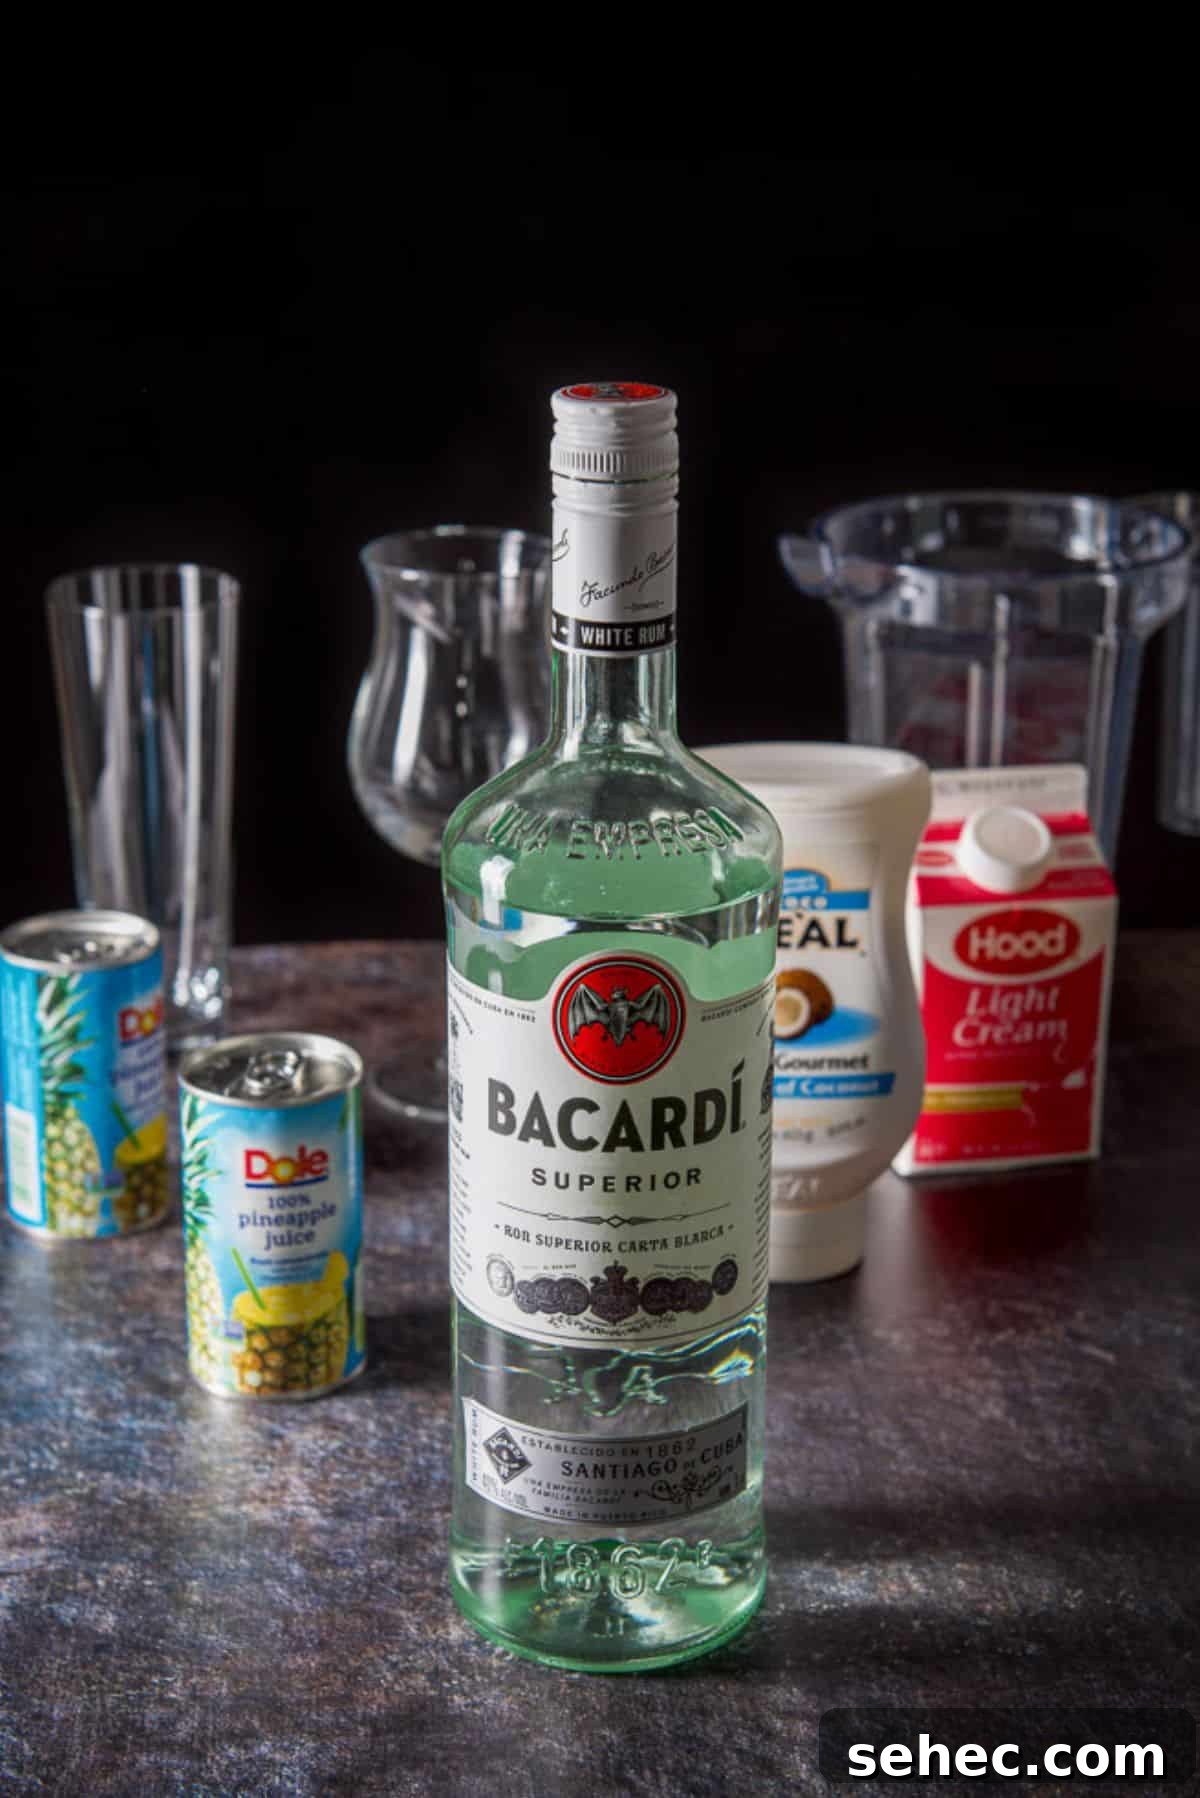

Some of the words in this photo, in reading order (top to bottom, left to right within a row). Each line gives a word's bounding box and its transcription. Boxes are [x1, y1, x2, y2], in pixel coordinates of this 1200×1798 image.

[581, 626, 633, 646] WHITE
[640, 623, 666, 642] RUM
[568, 806, 744, 860] EMPRESA
[968, 922, 1068, 961] Hood
[966, 985, 1059, 1020] Light
[952, 1017, 1068, 1047] Cream
[488, 1057, 745, 1153] BACARDÍ
[244, 1144, 329, 1184] Dole
[531, 1168, 702, 1193] SUPERIOR
[239, 1201, 337, 1230] pineapple
[268, 1193, 312, 1209] 100%
[264, 1229, 316, 1250] juice
[535, 1233, 613, 1253] SUPERIOR
[618, 1237, 669, 1253] CARTA
[522, 1435, 616, 1457] ESTABLECIDO
[561, 1458, 678, 1480] SANTIAGO
[700, 1431, 743, 1465] CUBA
[533, 1537, 688, 1600] 1862
